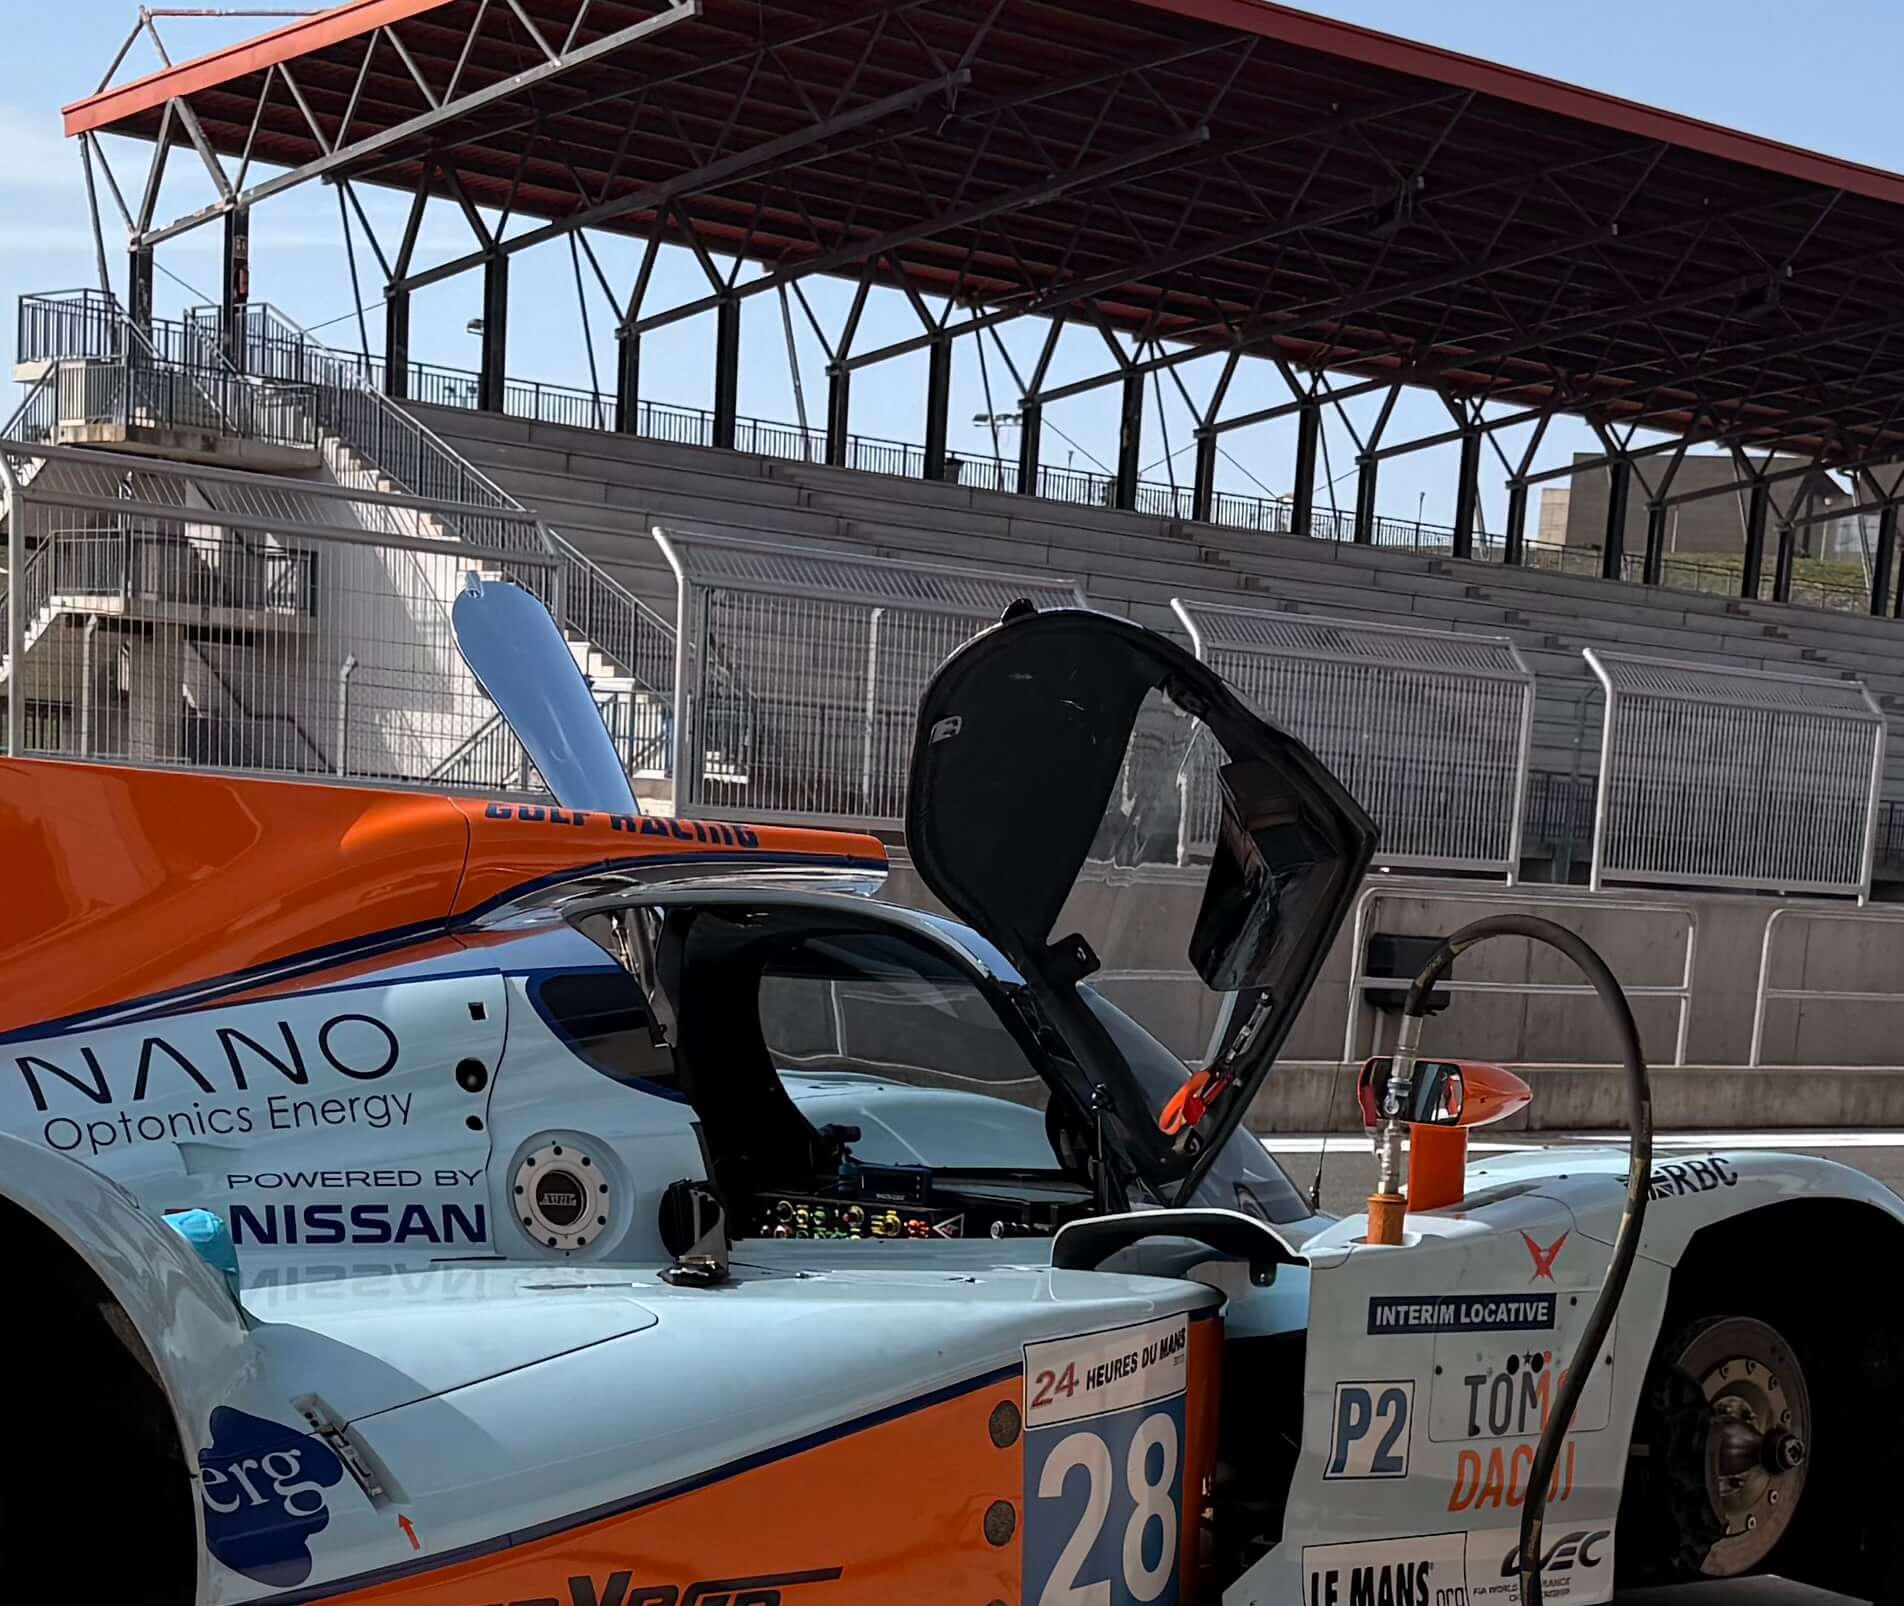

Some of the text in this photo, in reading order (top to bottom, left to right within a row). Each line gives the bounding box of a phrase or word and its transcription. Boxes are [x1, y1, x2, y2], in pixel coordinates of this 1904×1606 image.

[15, 1013, 400, 1112] NANO
[43, 1090, 414, 1155] Optonics Energy
[227, 1168, 484, 1190] POWERED BY
[230, 1203, 487, 1246] NISSAN
[1375, 1302, 1549, 1326] INTERIM LOCATIVE
[1030, 1327, 1186, 1409] 24 HEURES DU MANS
[1329, 1387, 1408, 1475] P2
